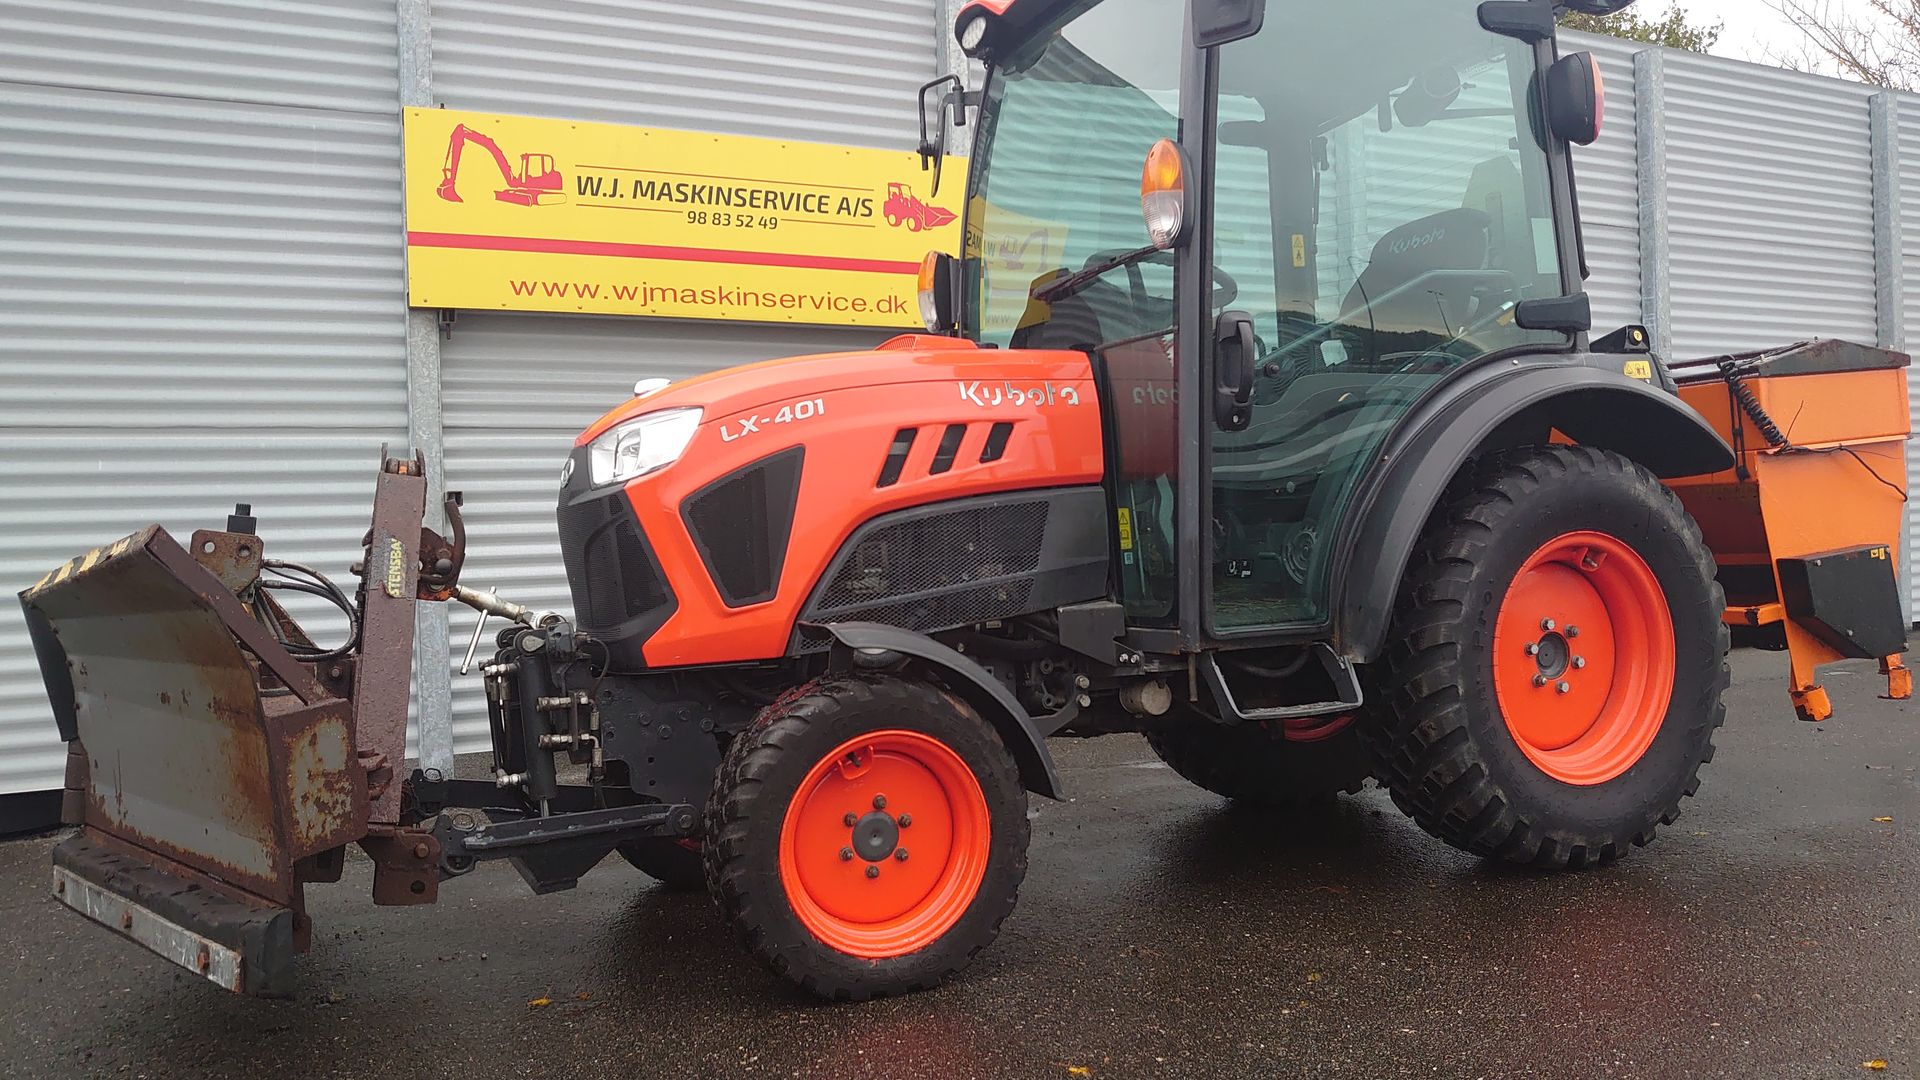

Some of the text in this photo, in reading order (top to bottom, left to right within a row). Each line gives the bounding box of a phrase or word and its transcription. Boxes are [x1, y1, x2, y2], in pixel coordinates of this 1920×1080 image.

[576, 175, 874, 218] W.J. MASKINSERVICE A/S
[686, 210, 778, 230] 98 83 52 49
[509, 279, 909, 315] www.wjmaskinservice.dk
[957, 380, 1080, 407] Kubota
[719, 398, 825, 442] LX-401
